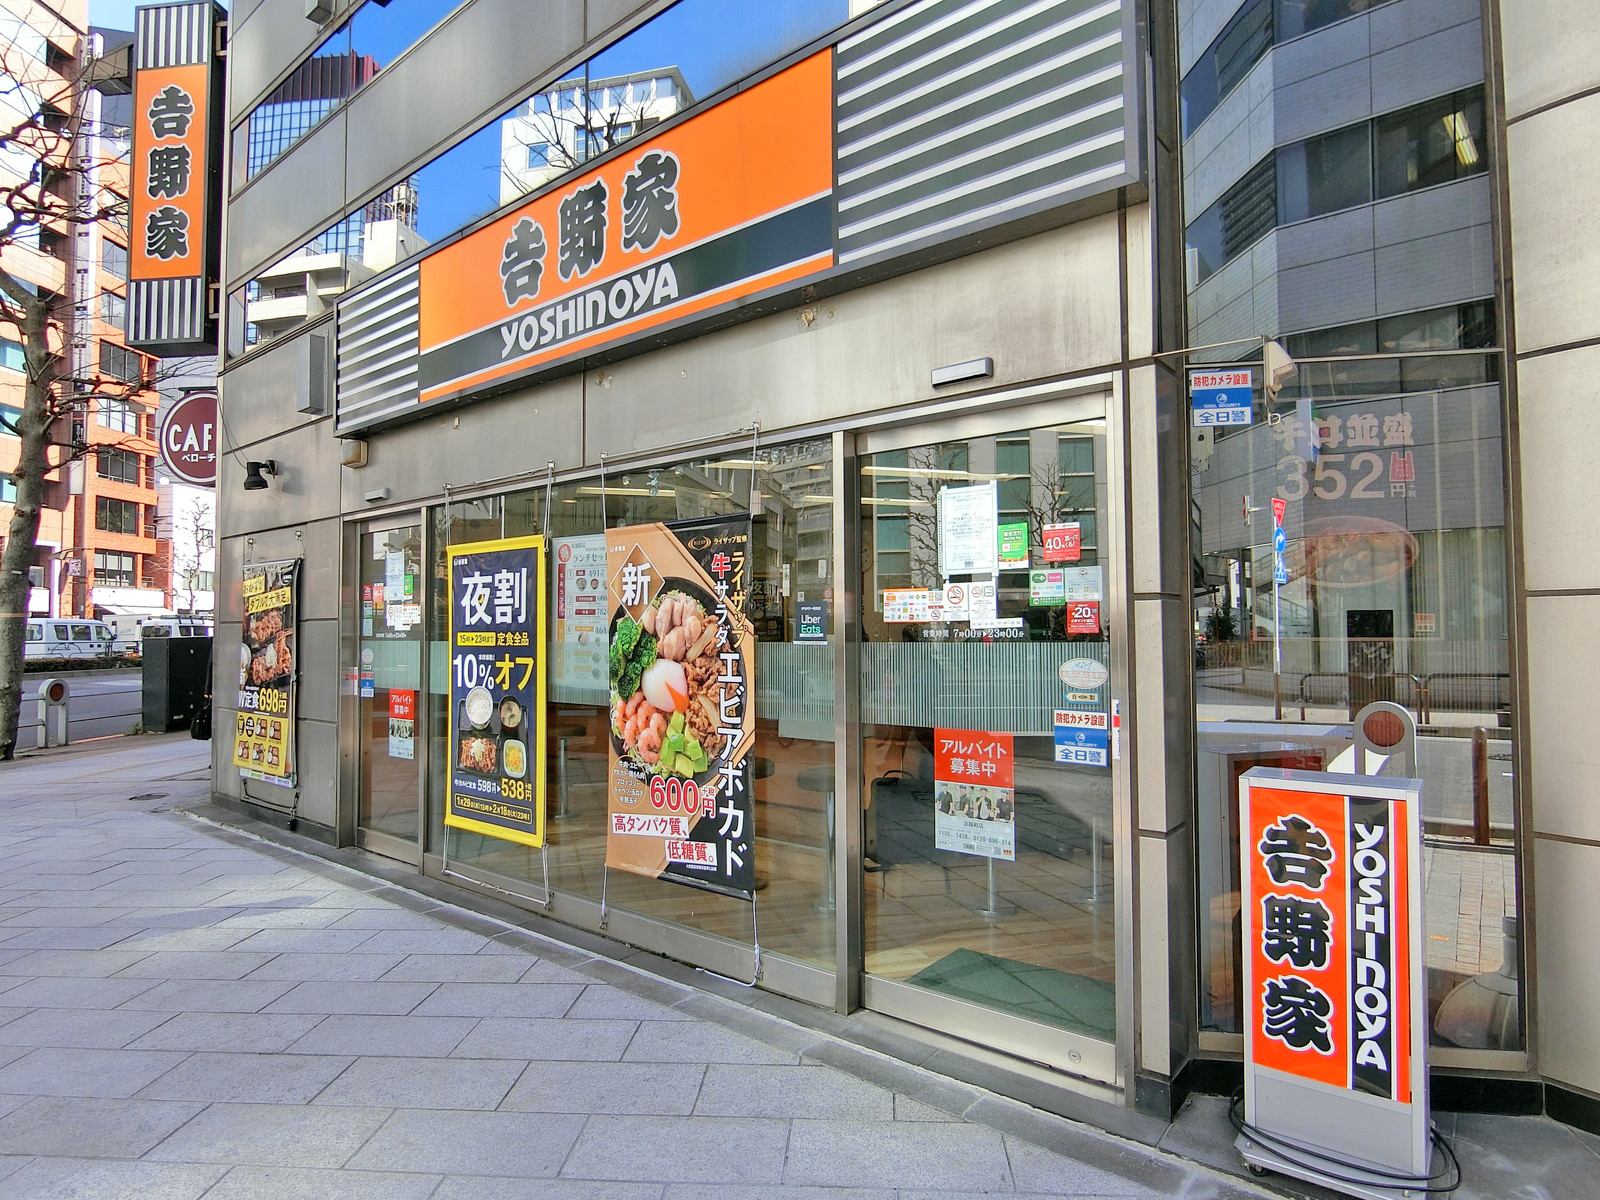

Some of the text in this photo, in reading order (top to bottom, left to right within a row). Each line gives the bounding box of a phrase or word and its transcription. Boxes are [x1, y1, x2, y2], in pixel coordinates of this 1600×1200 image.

[146, 84, 196, 262] 吉野家
[499, 149, 681, 308] 吉野家
[1193, 373, 1249, 388] 防犯カメラ設置
[1198, 410, 1246, 424] 全日警
[621, 562, 651, 606] 新
[461, 567, 528, 626] 夜割
[801, 614, 821, 624] Uber
[801, 624, 821, 633] Eats
[1056, 712, 1105, 727] 防犯カメラ設置
[940, 739, 1007, 759] アルバイト
[1060, 748, 1102, 763] 全日警
[950, 757, 996, 777] 募集中
[1257, 813, 1336, 1056] 吉野家
